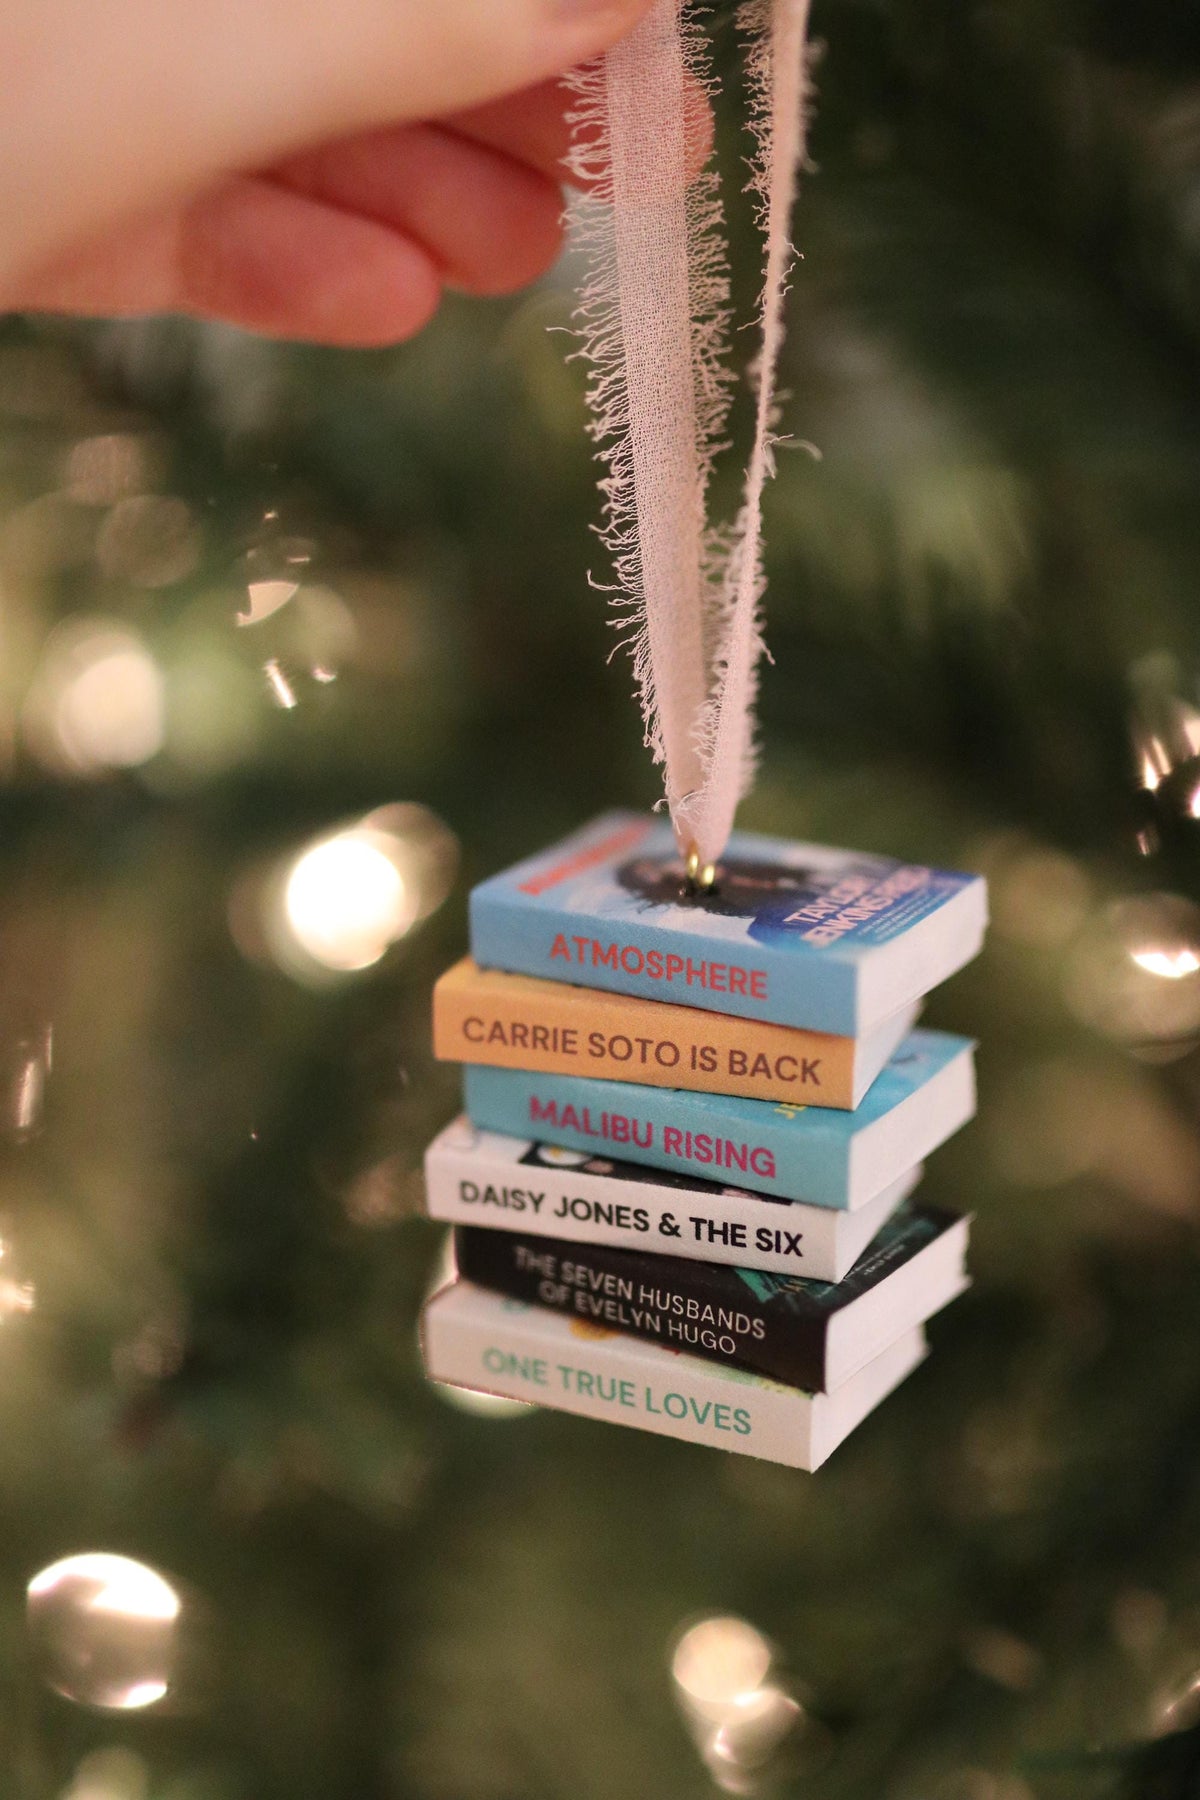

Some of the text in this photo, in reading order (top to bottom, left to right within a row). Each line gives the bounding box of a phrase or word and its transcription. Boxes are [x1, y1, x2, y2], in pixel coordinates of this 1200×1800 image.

[783, 876, 870, 924] TAYLO
[549, 933, 768, 999] ATMOSPHERE
[462, 1016, 822, 1086] CARRIE SOTO IS BACK
[529, 1095, 776, 1178] MALIBU RISING
[459, 1180, 804, 1257] DAISY JONES & THE SIX
[513, 1246, 766, 1340] THE SEVEN HUSBANDS
[538, 1281, 736, 1355] OF EVELYN HUGO
[482, 1347, 752, 1435] ONE TRUE LOVES
